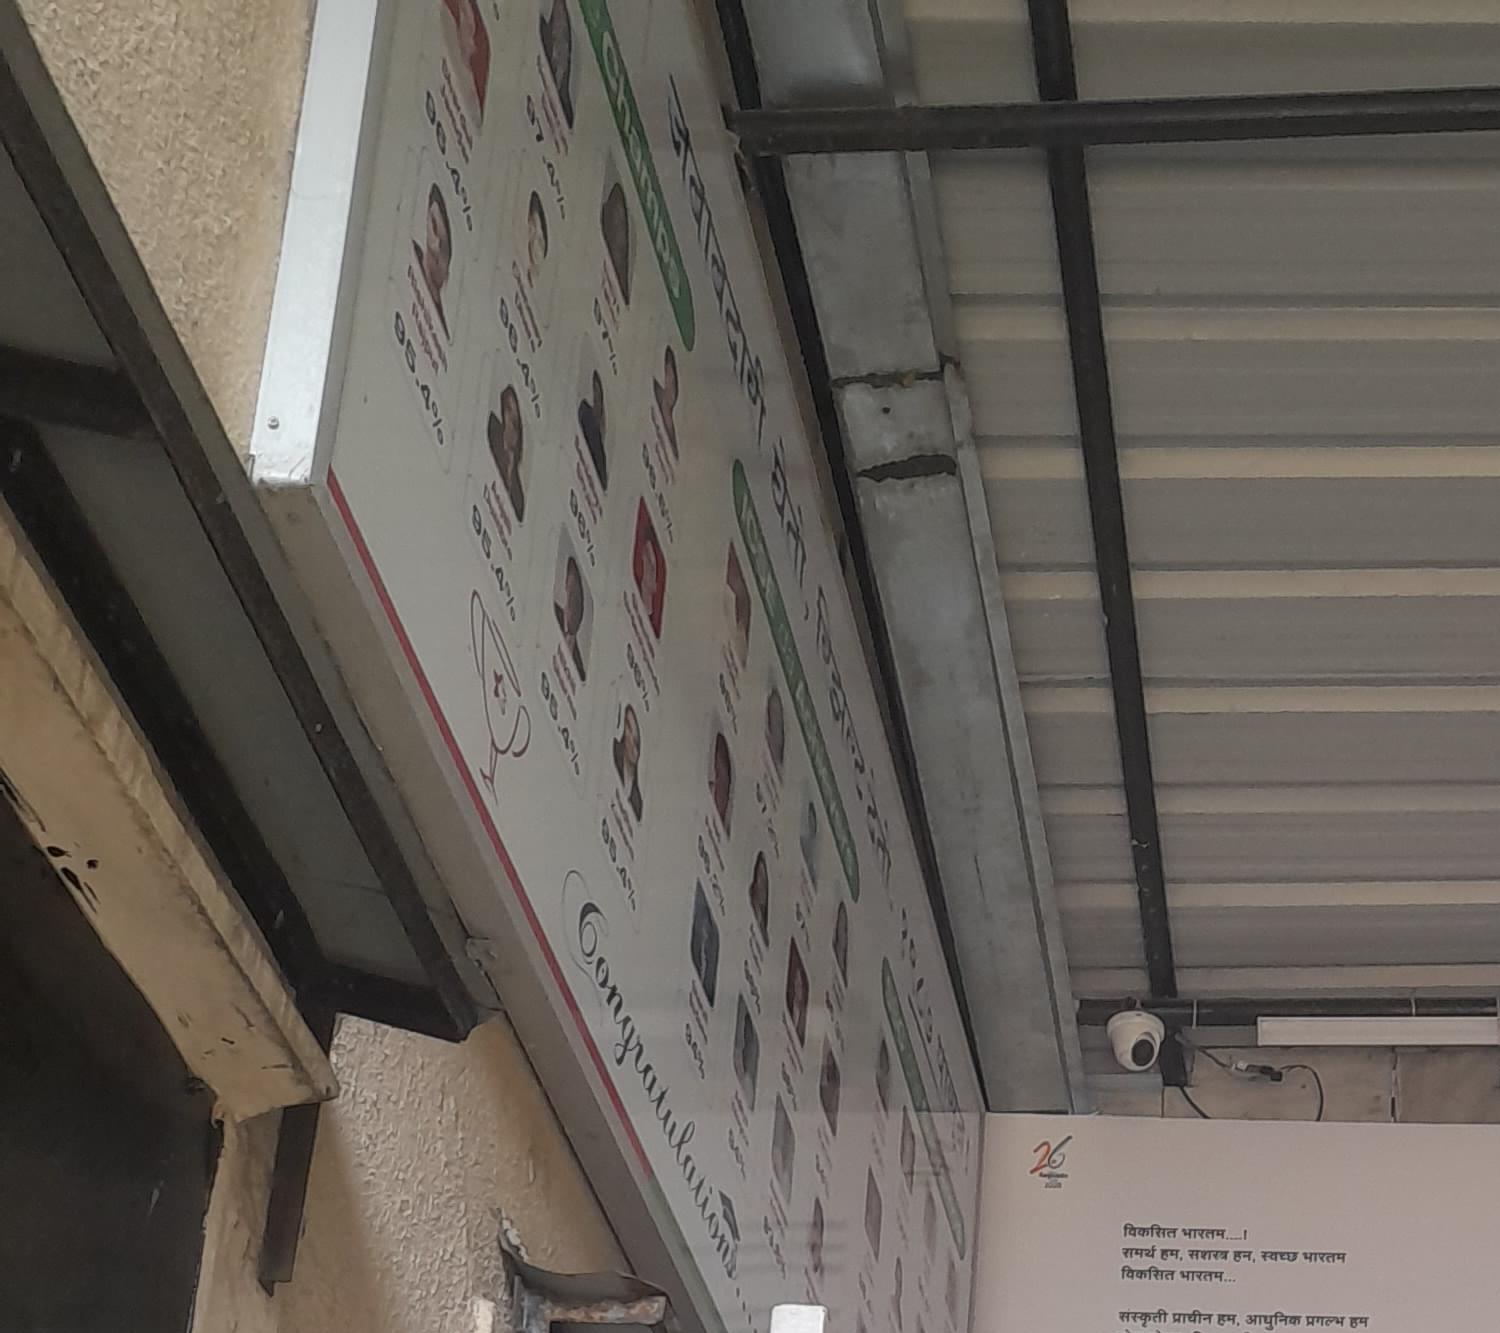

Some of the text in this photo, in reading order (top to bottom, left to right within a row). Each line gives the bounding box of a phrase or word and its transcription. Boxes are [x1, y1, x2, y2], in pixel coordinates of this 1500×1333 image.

[394, 310, 445, 446] 95.4%
[472, 503, 517, 622] 95.4%
[540, 670, 581, 778] 95.4%
